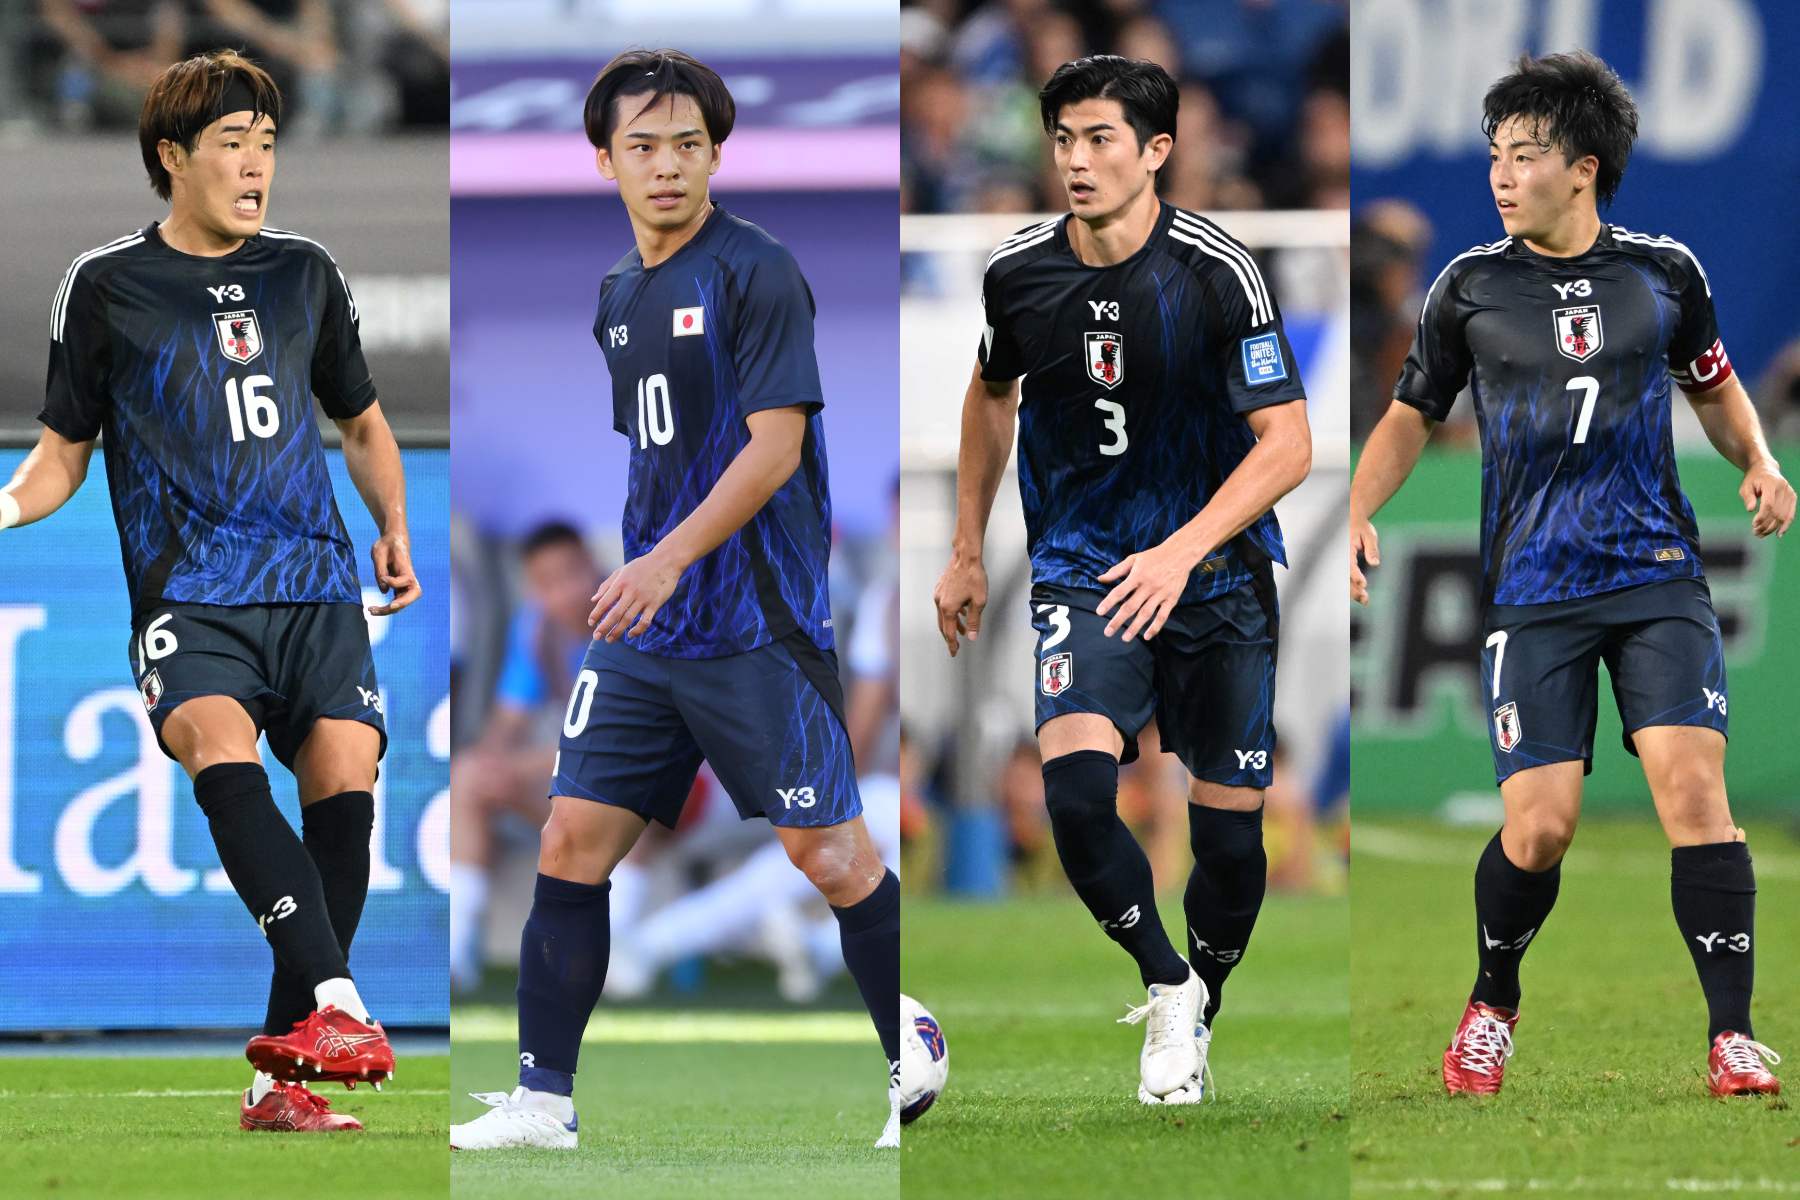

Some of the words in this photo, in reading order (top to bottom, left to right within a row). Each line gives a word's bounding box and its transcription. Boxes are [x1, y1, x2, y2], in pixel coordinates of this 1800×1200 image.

[207, 285, 245, 303] Y-3
[1552, 279, 1592, 300] Y-3
[1088, 300, 1120, 321] Y-3
[609, 325, 628, 348] Y-3
[1250, 341, 1274, 351] FOOTBALL
[1571, 342, 1590, 352] JFA
[234, 346, 252, 355] JFA
[1251, 347, 1275, 360] UNITES
[1100, 370, 1116, 379] JFA
[225, 375, 279, 442] 16
[638, 373, 674, 450] 10
[1566, 376, 1600, 444] 7
[1095, 398, 1129, 456] 3
[1037, 604, 1071, 652] 3
[1485, 631, 1508, 700] 7
[356, 685, 383, 714] Y-3
[1702, 687, 1726, 715] Y-3
[1234, 749, 1267, 770] Y-3
[775, 786, 816, 810] Y-3
[1189, 925, 1240, 963] Y-3
[1483, 923, 1535, 950] Y-3
[1696, 931, 1750, 953] Y-3
